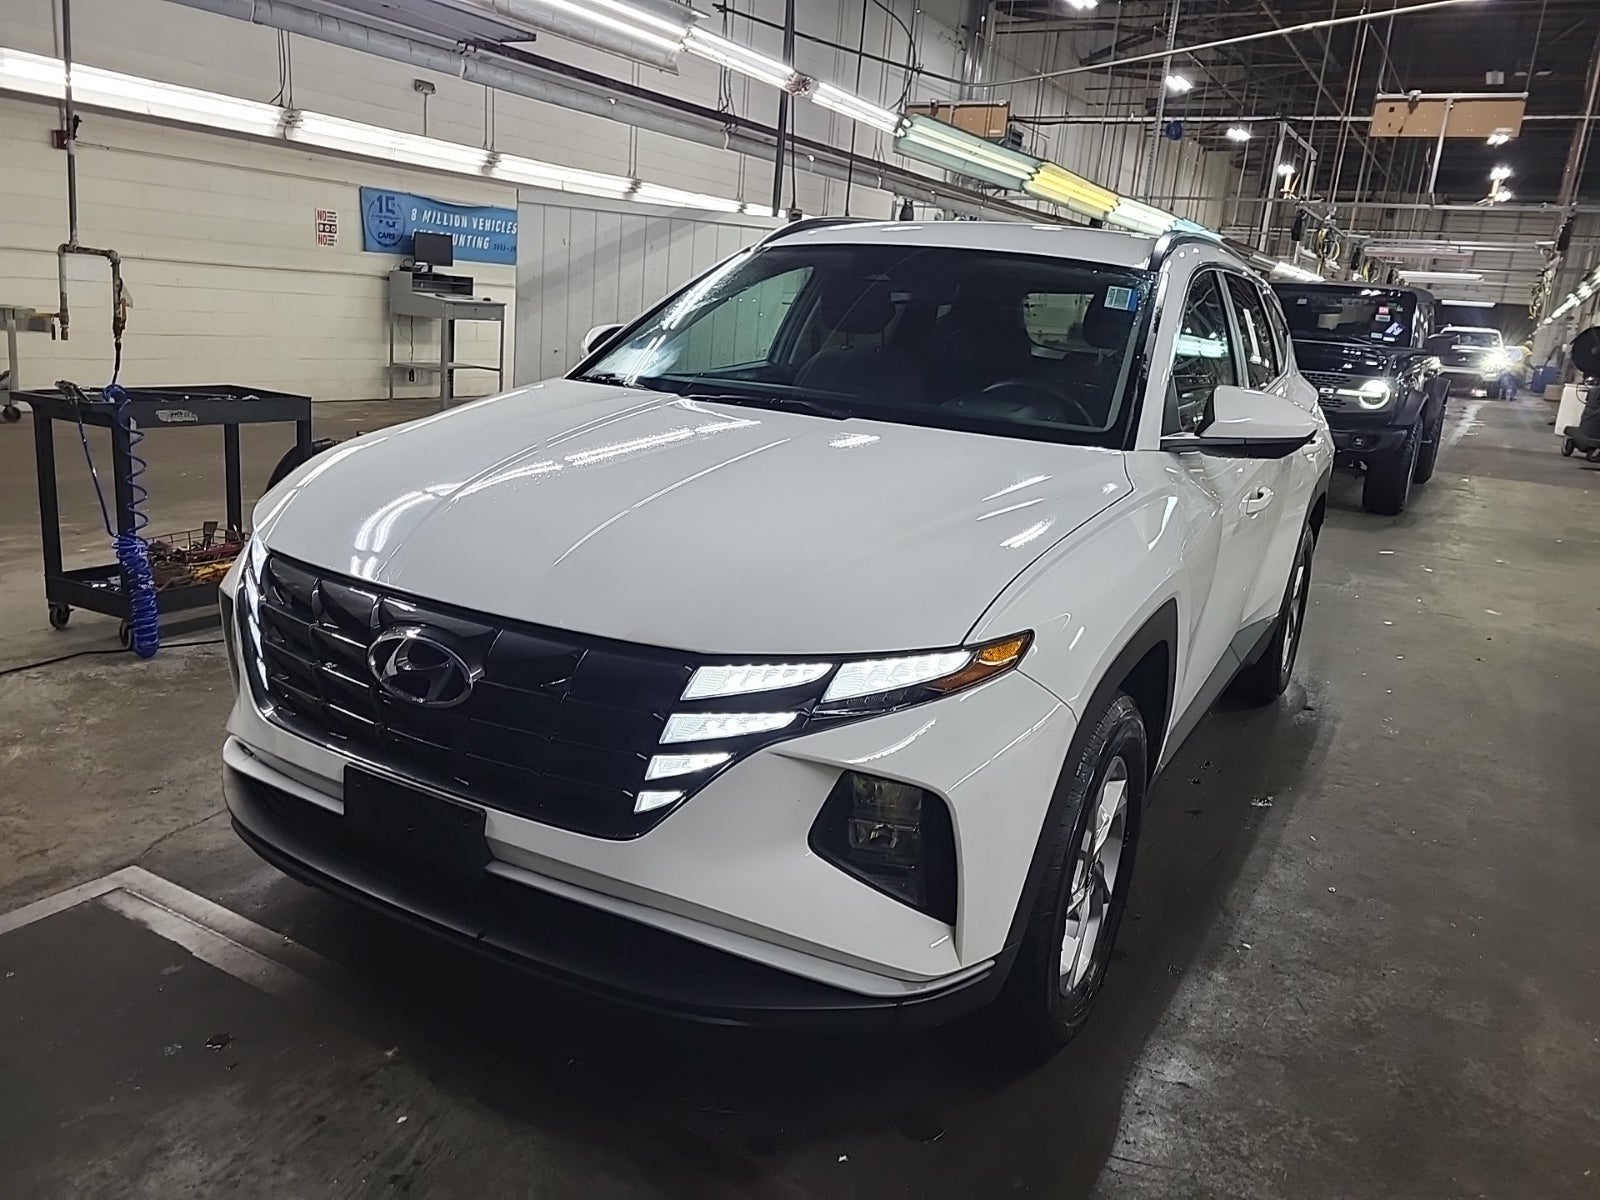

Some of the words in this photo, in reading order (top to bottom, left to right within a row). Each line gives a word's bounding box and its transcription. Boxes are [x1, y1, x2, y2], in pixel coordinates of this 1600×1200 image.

[317, 209, 327, 222] NO
[411, 208, 418, 221] 8
[422, 209, 467, 228] MILLION
[472, 217, 517, 234] VEHICLES
[318, 233, 328, 246] NO
[440, 232, 490, 249] UNTING
